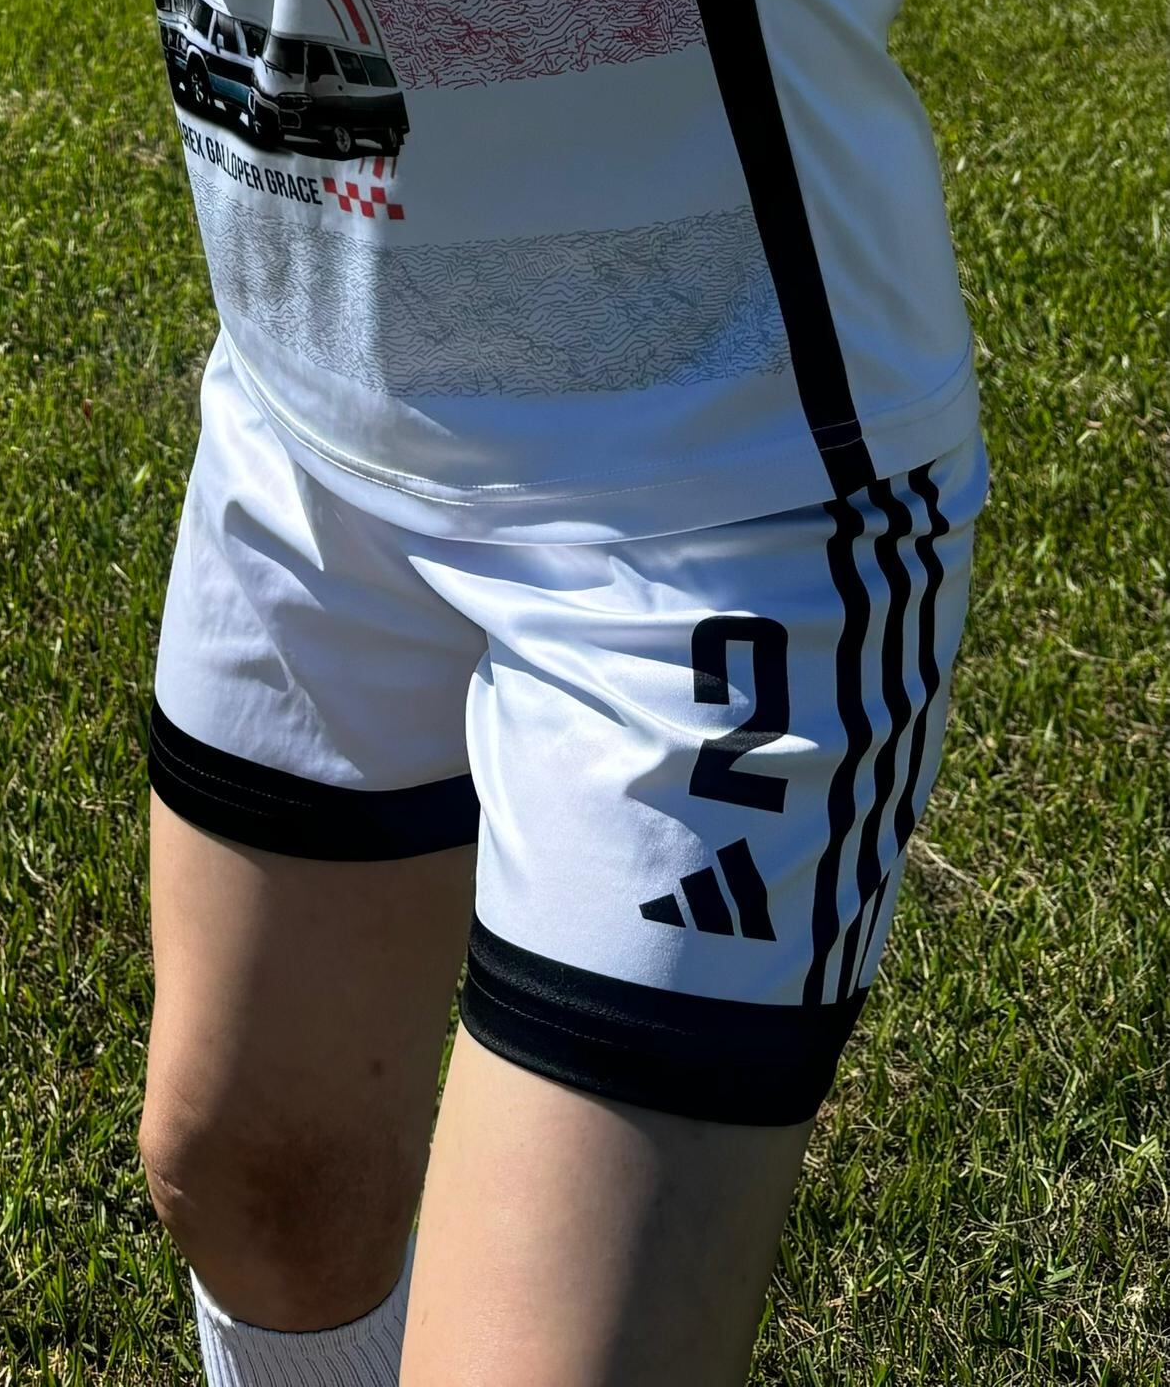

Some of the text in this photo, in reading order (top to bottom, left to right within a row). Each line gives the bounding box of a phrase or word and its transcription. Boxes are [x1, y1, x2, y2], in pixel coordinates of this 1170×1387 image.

[205, 136, 265, 193] GALLOPER
[263, 167, 324, 206] GRACE
[688, 615, 791, 815] 2
